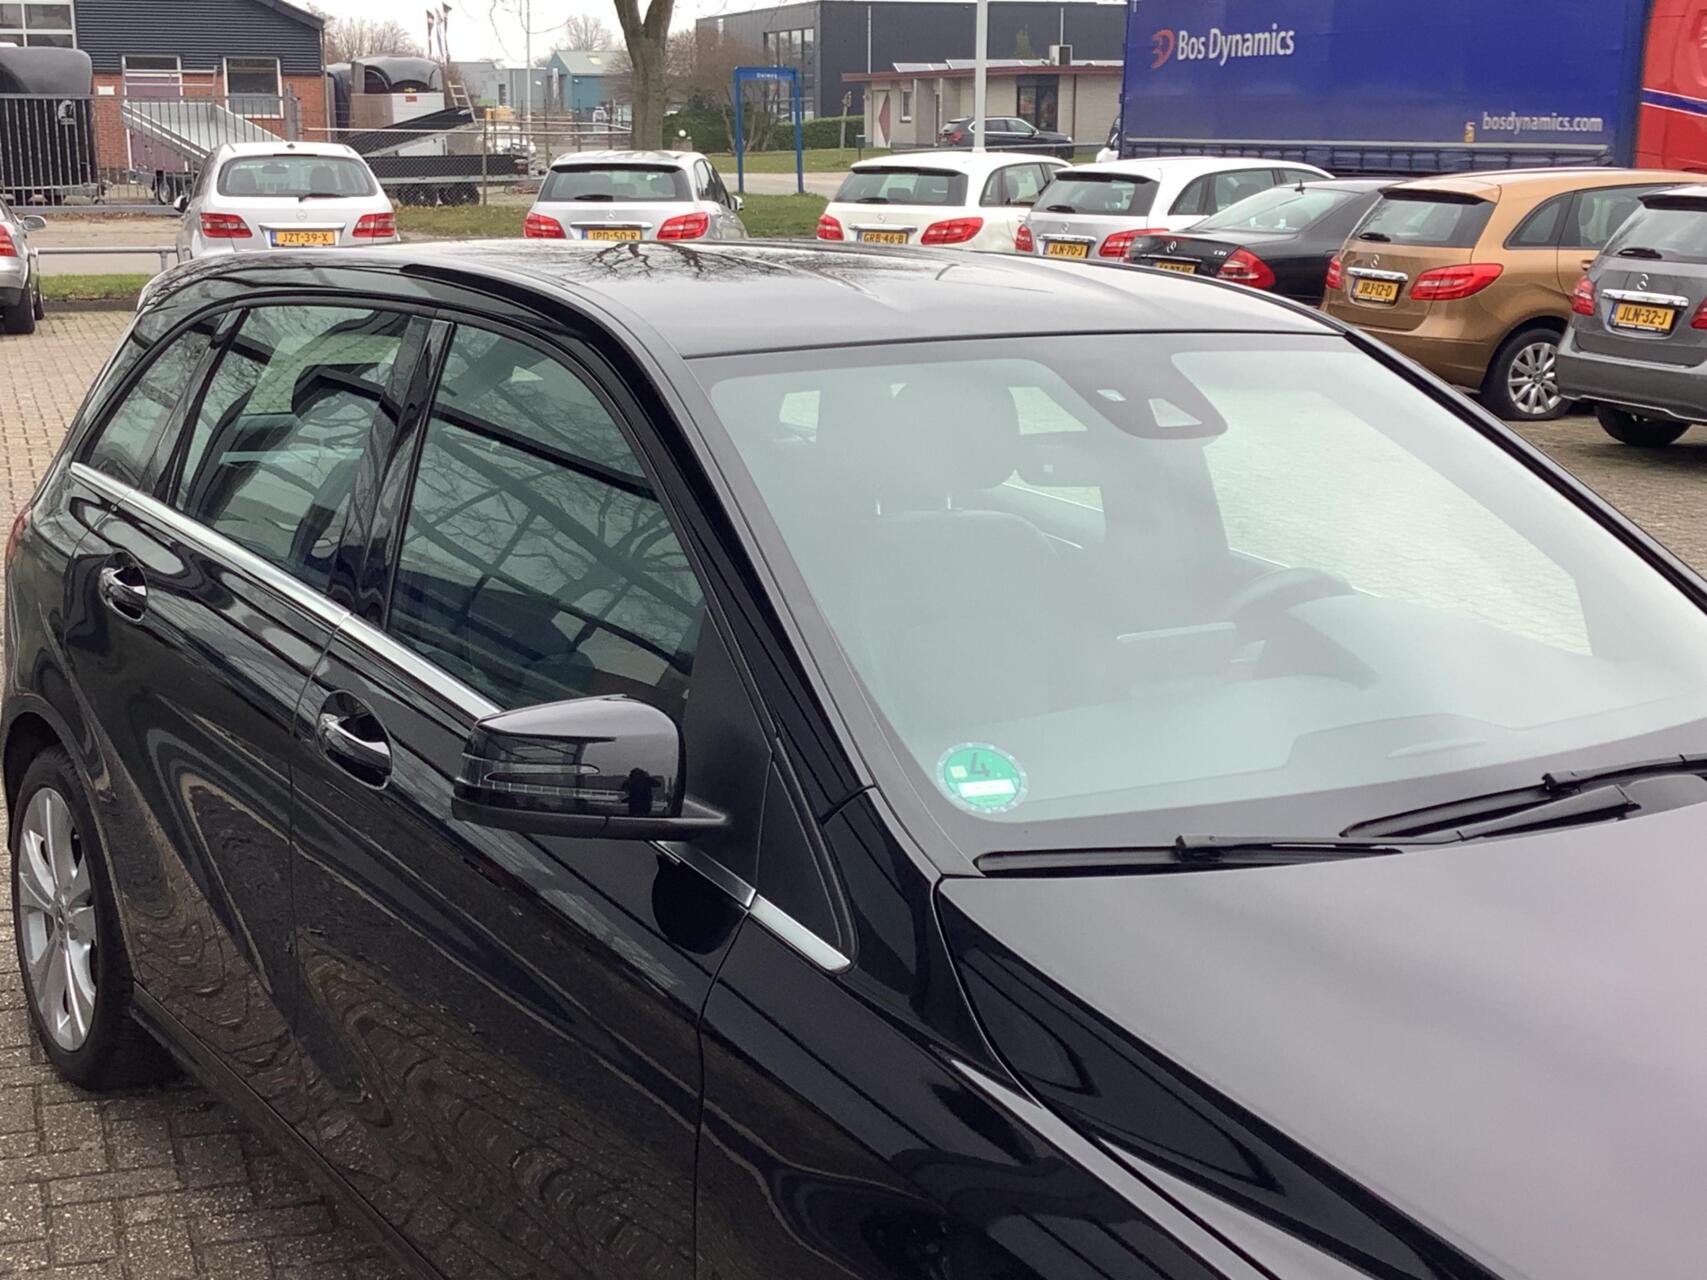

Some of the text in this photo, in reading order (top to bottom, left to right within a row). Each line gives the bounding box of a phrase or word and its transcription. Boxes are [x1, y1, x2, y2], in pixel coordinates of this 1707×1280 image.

[1176, 22, 1295, 67] Bos Dynamics
[1482, 111, 1603, 135] bosdynamics.com
[282, 232, 329, 243] JZT-39-X
[1050, 243, 1084, 256] JLN-70-J
[1619, 305, 1668, 326] JLN-32-J
[968, 751, 992, 777] 4
